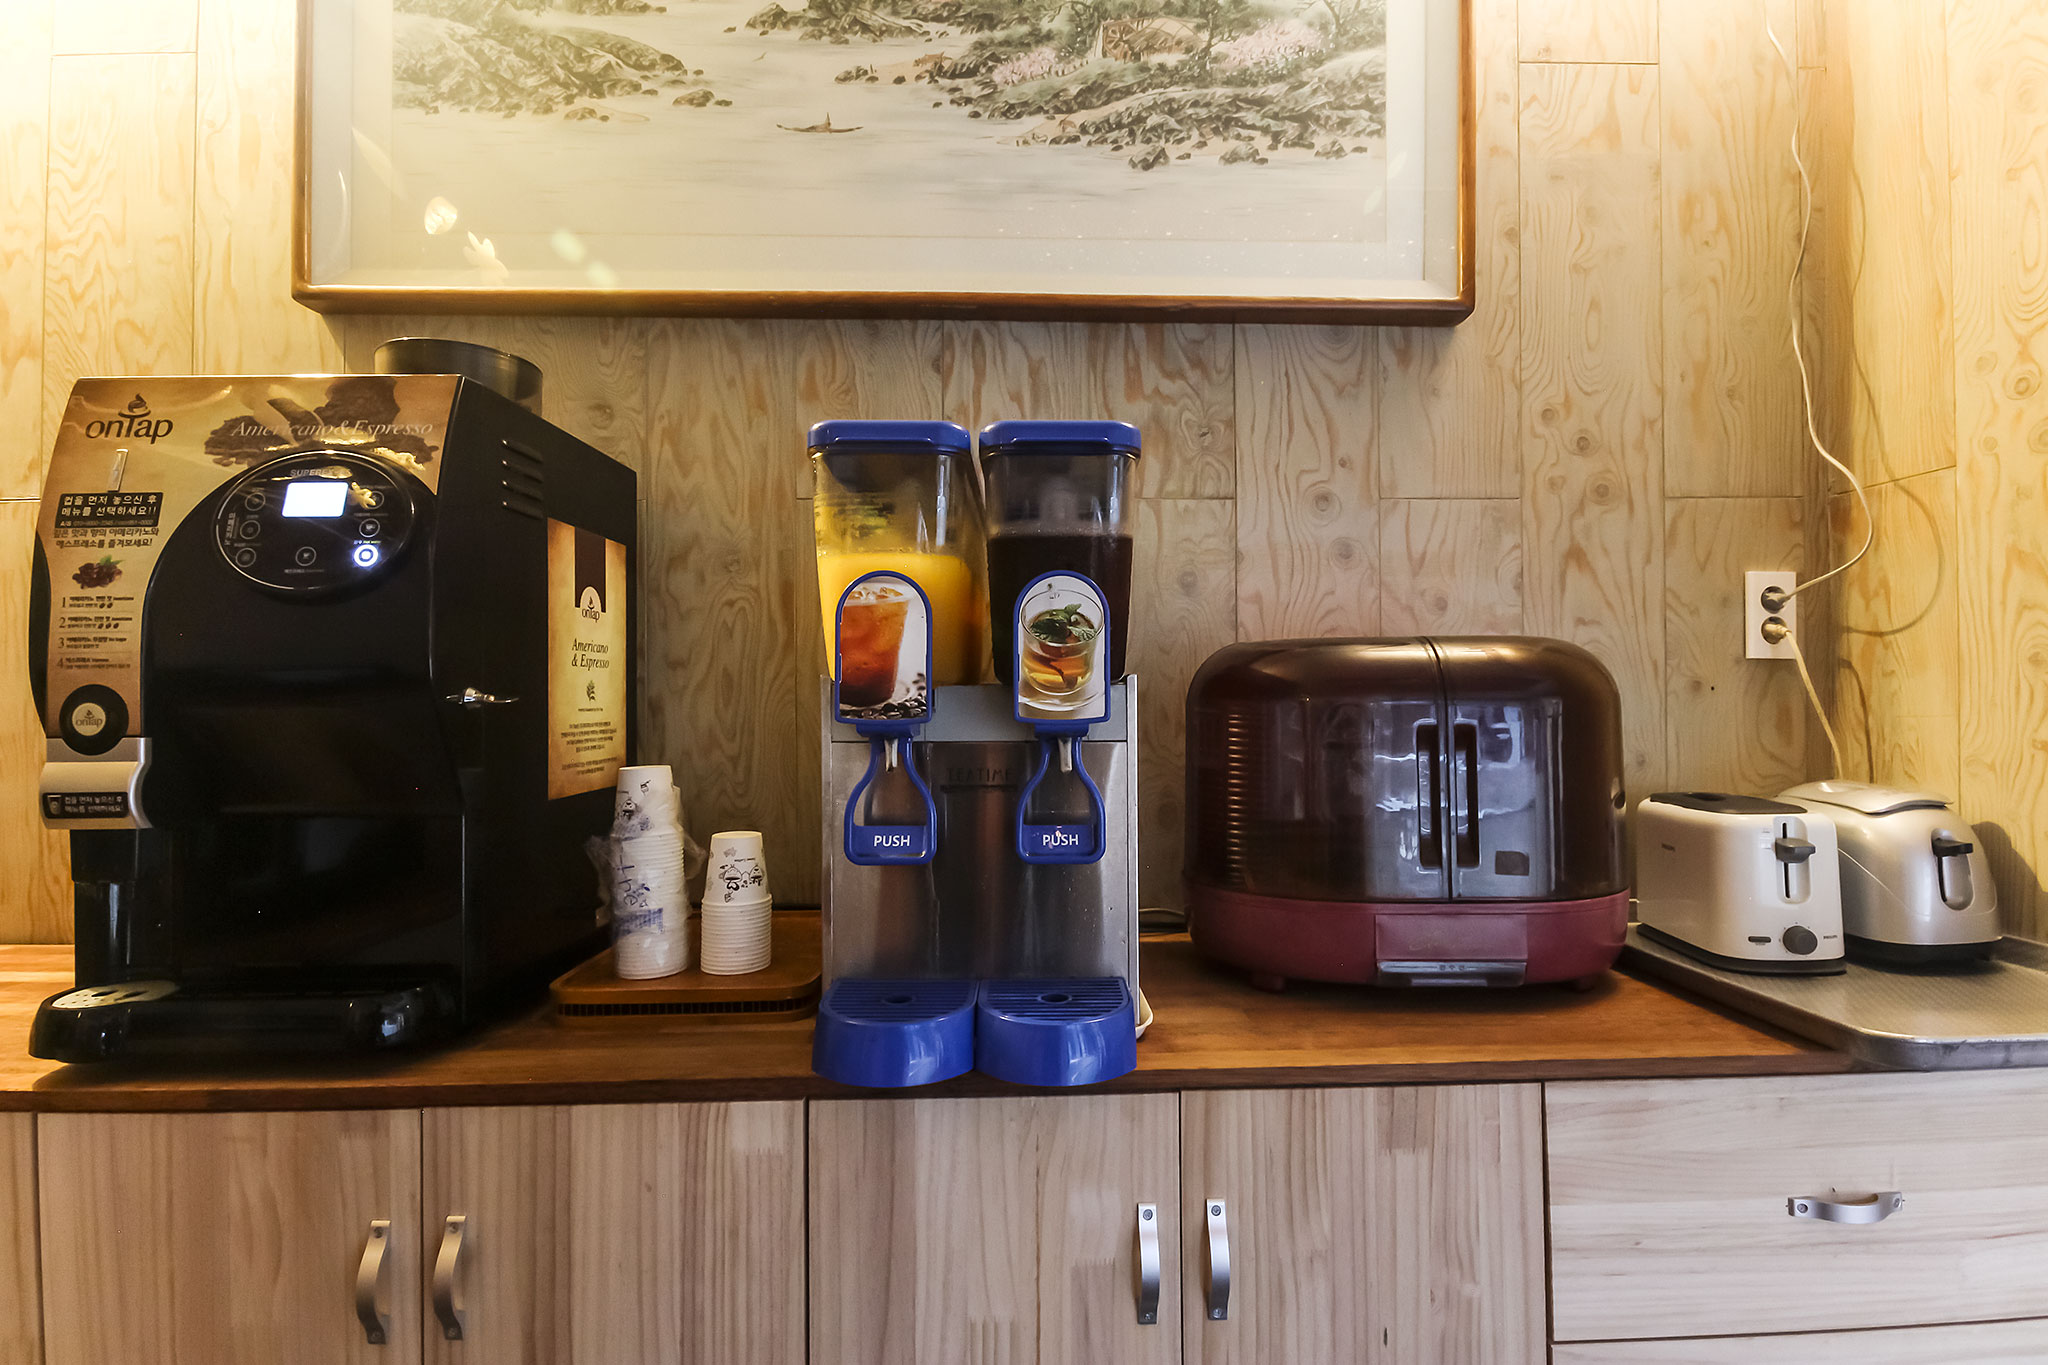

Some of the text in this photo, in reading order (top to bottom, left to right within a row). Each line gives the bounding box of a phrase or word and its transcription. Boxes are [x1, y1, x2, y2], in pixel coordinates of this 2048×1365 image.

[64, 494, 157, 506] 컵을 먼저 놓으신 후
[61, 506, 157, 517] 메뉴를 선택하세요!!
[572, 638, 609, 654] Americano
[580, 653, 610, 671] Espresso
[874, 835, 911, 847] PUSH
[1042, 834, 1079, 846] PUSH
